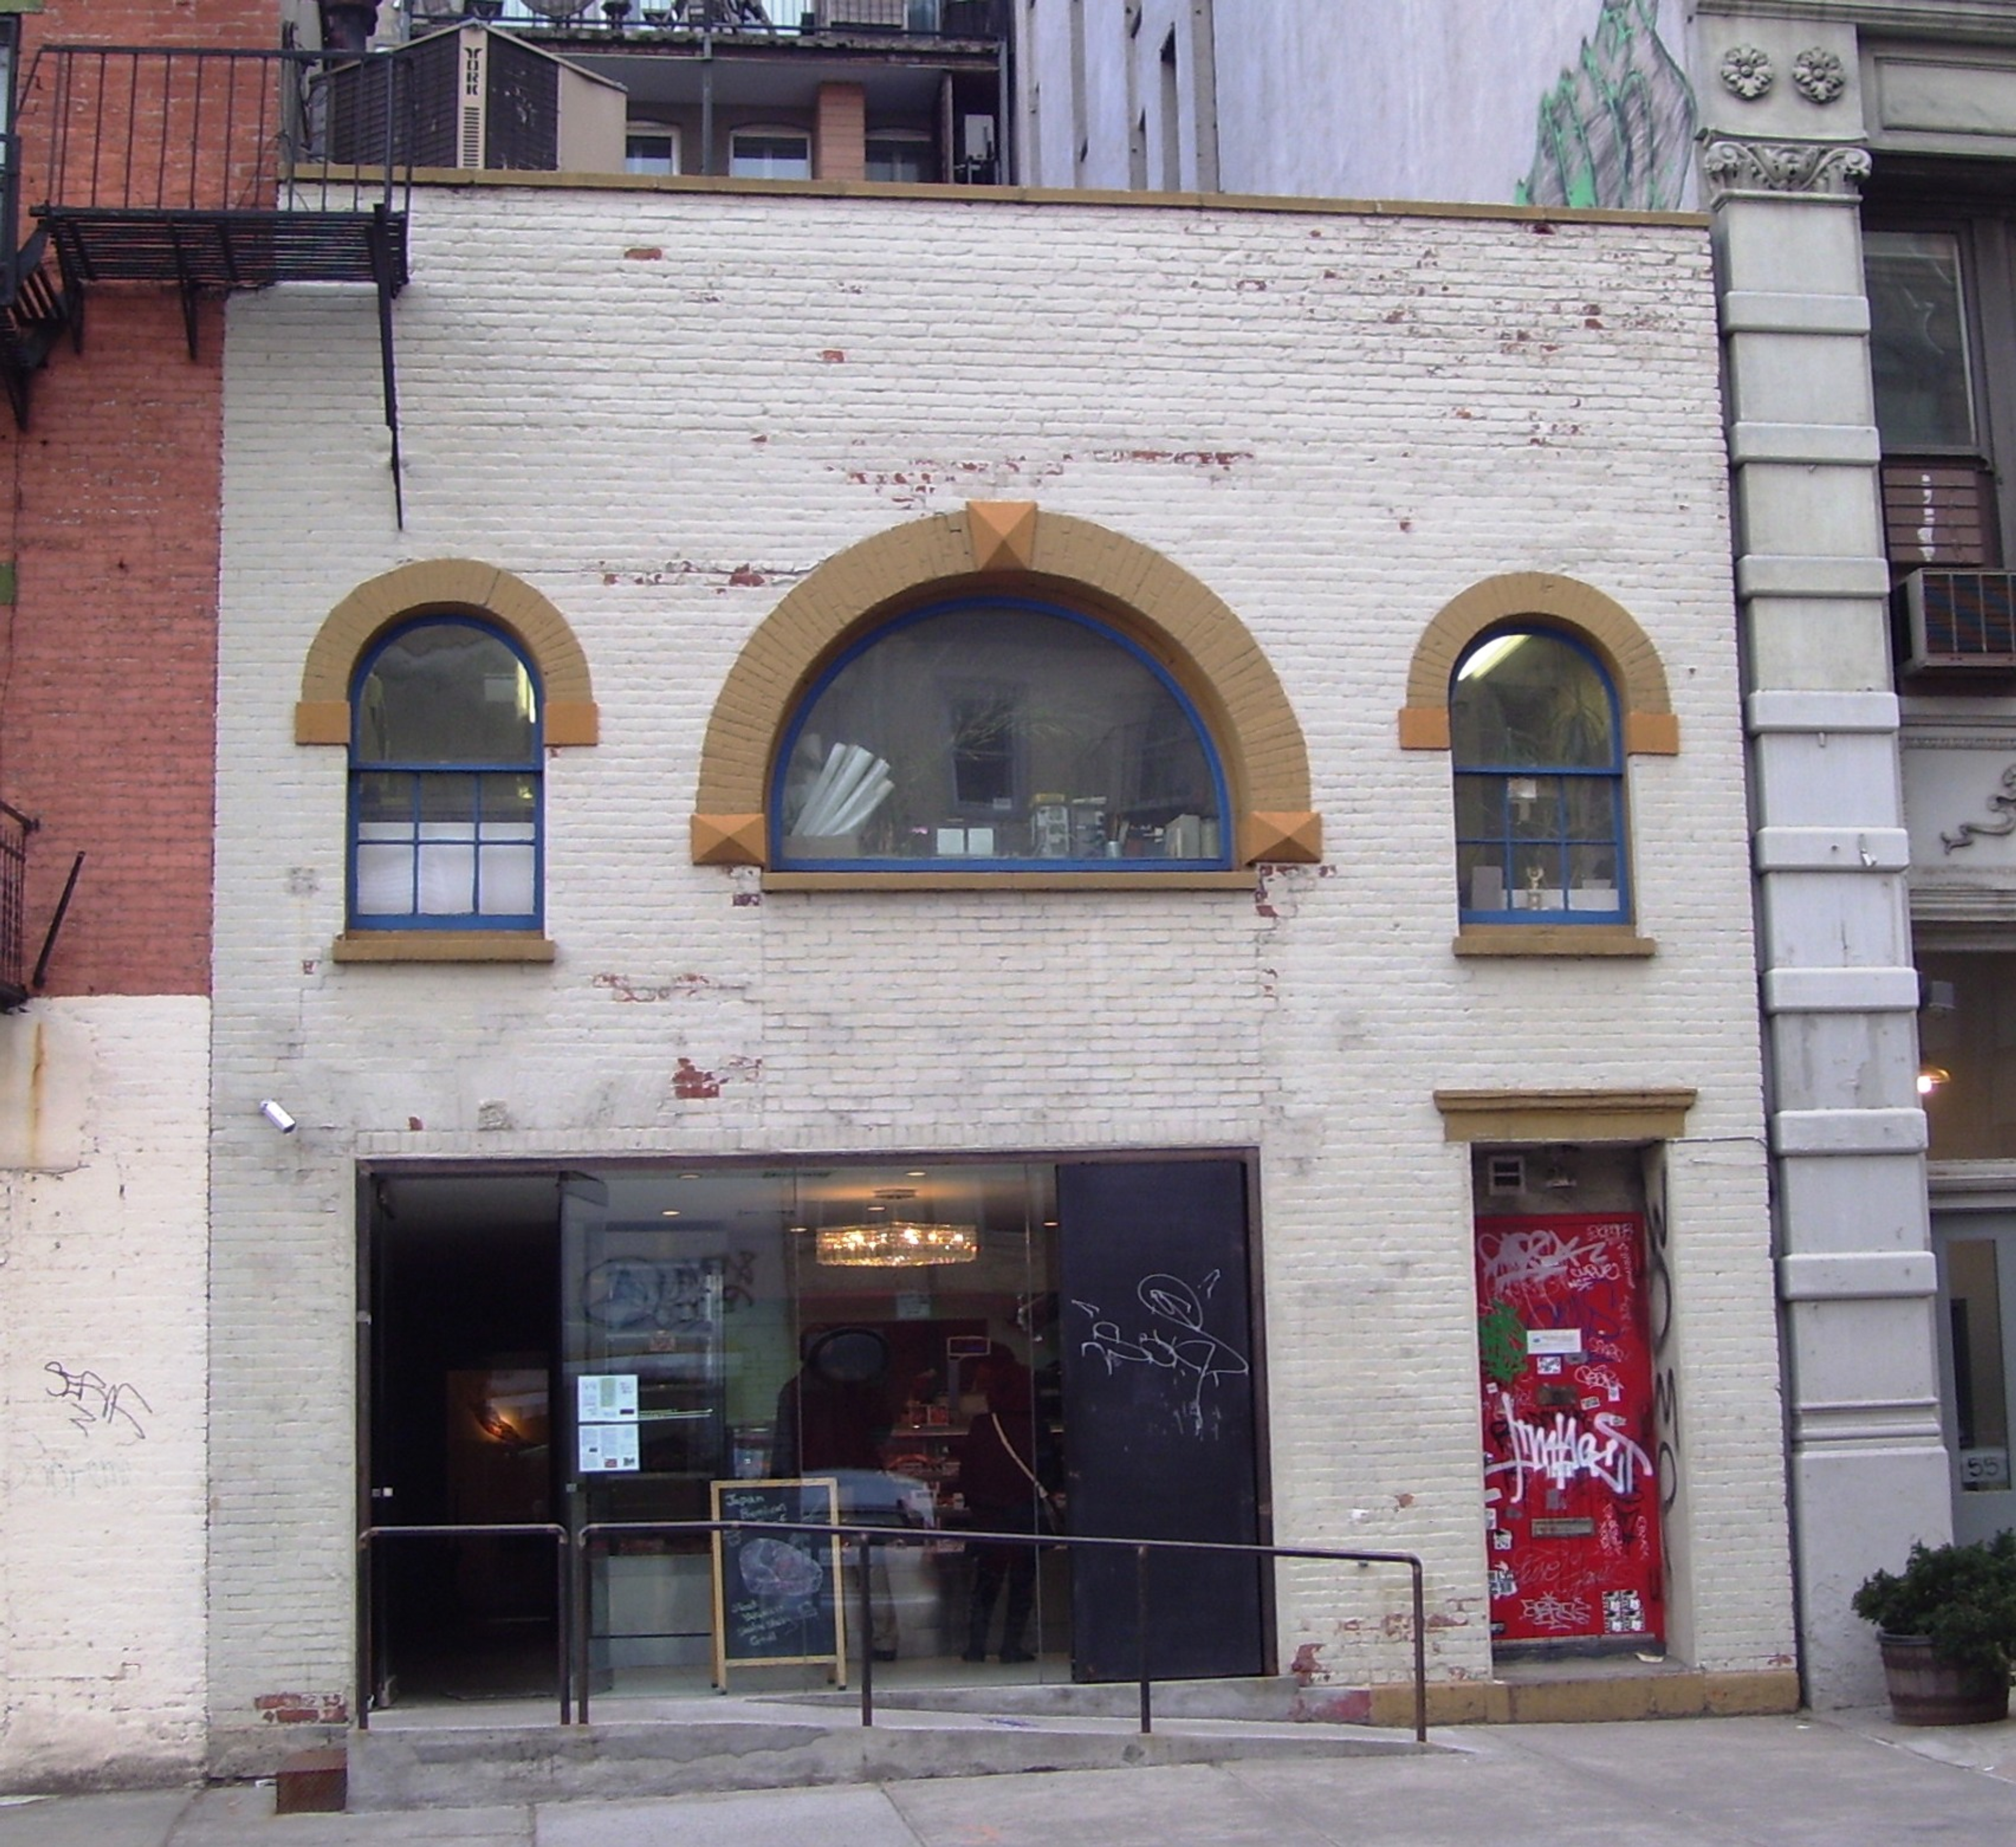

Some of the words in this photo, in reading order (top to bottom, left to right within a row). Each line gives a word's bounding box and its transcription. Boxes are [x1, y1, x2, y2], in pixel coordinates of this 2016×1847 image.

[464, 47, 483, 96] YORK
[1968, 1457, 1999, 1477] 55
[725, 1494, 764, 1506] Japan
